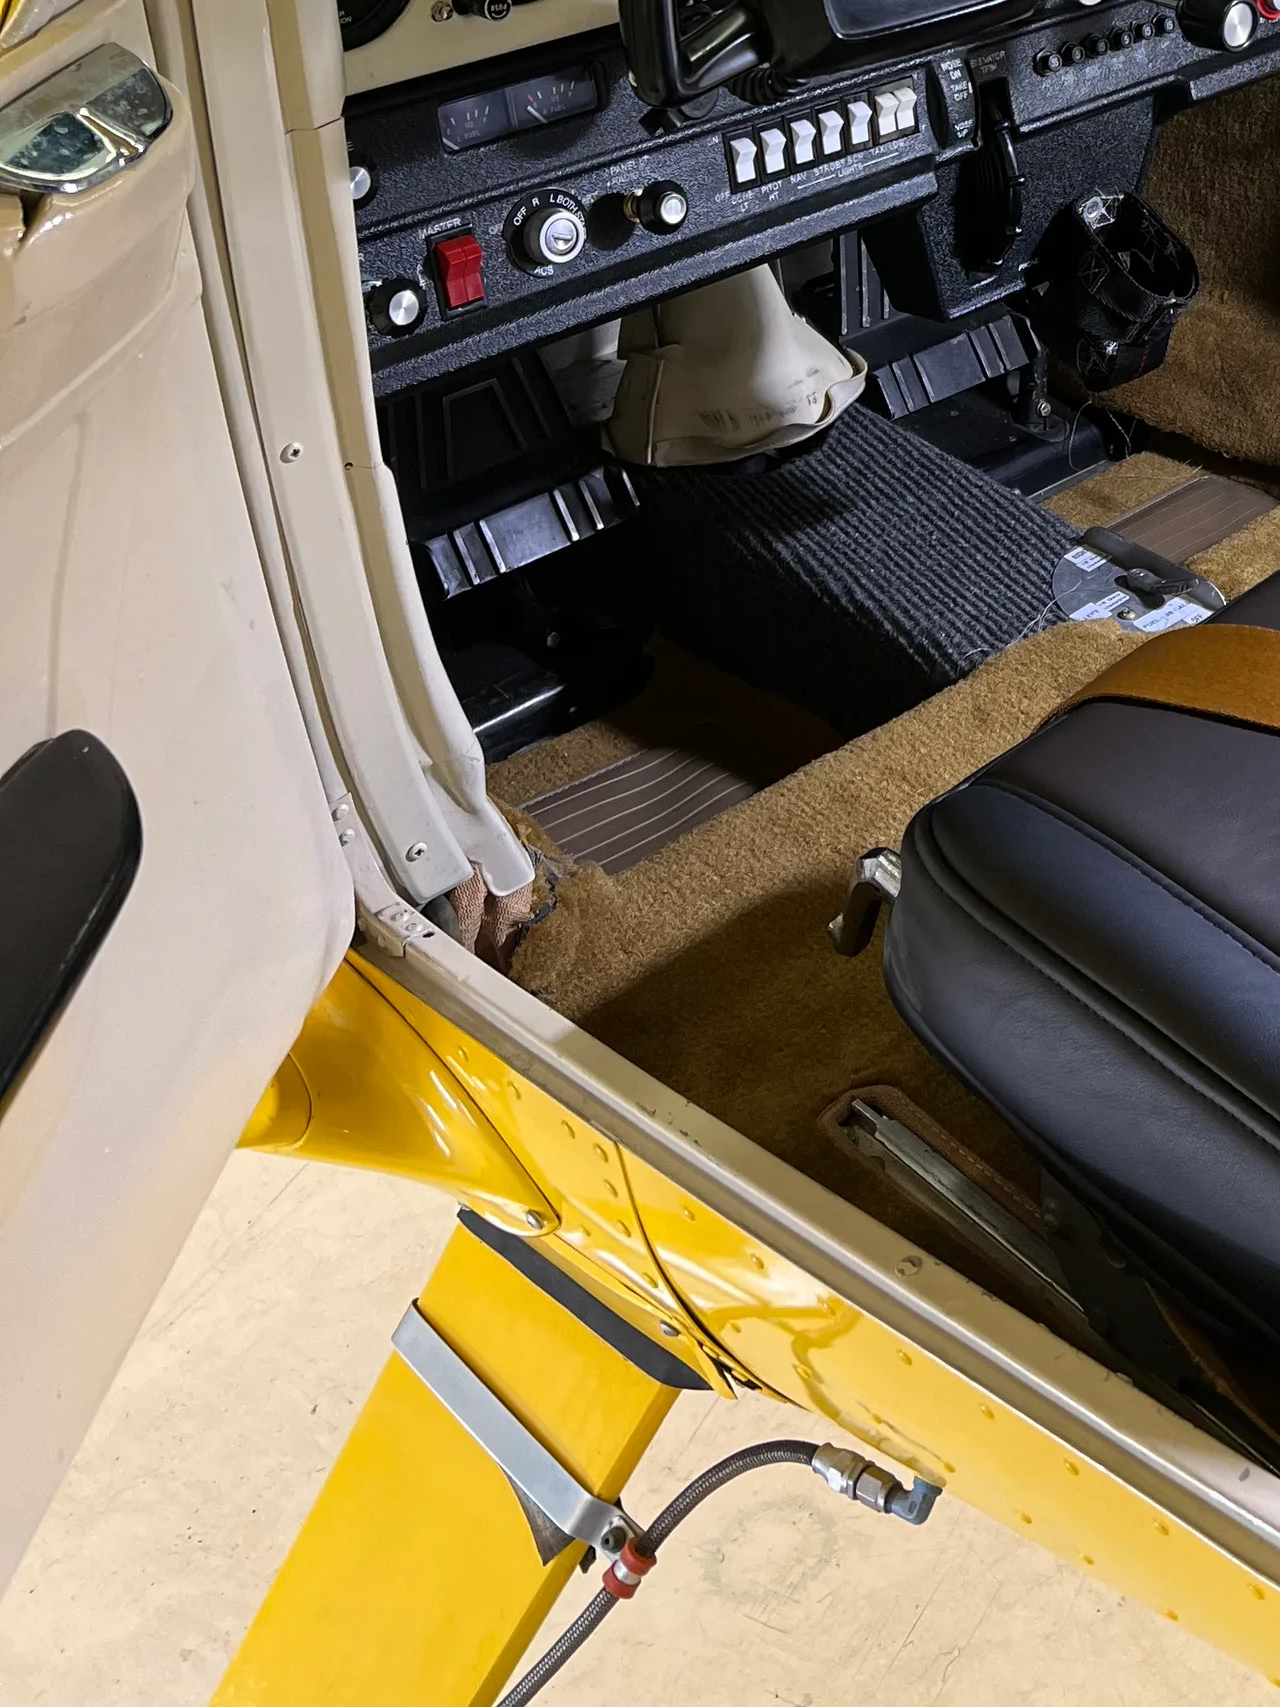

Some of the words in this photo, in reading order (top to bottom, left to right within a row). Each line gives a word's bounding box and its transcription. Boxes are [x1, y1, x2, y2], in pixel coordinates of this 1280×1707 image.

[940, 58, 963, 72] NOSE
[969, 50, 1006, 68] ELEVATOR
[950, 81, 967, 92] TAKE
[953, 92, 968, 102] OFF
[954, 119, 973, 131] NOSE
[837, 162, 864, 178] LIGHTS
[790, 171, 807, 185] NAV
[715, 191, 731, 203] OFF
[761, 181, 783, 194] PITOT
[768, 191, 779, 201] HT
[513, 206, 528, 227] OFF
[532, 198, 541, 207] R
[549, 193, 557, 203] L
[556, 195, 579, 214] BOTH
[418, 217, 462, 240] MASTER
[534, 265, 554, 276] ACS
